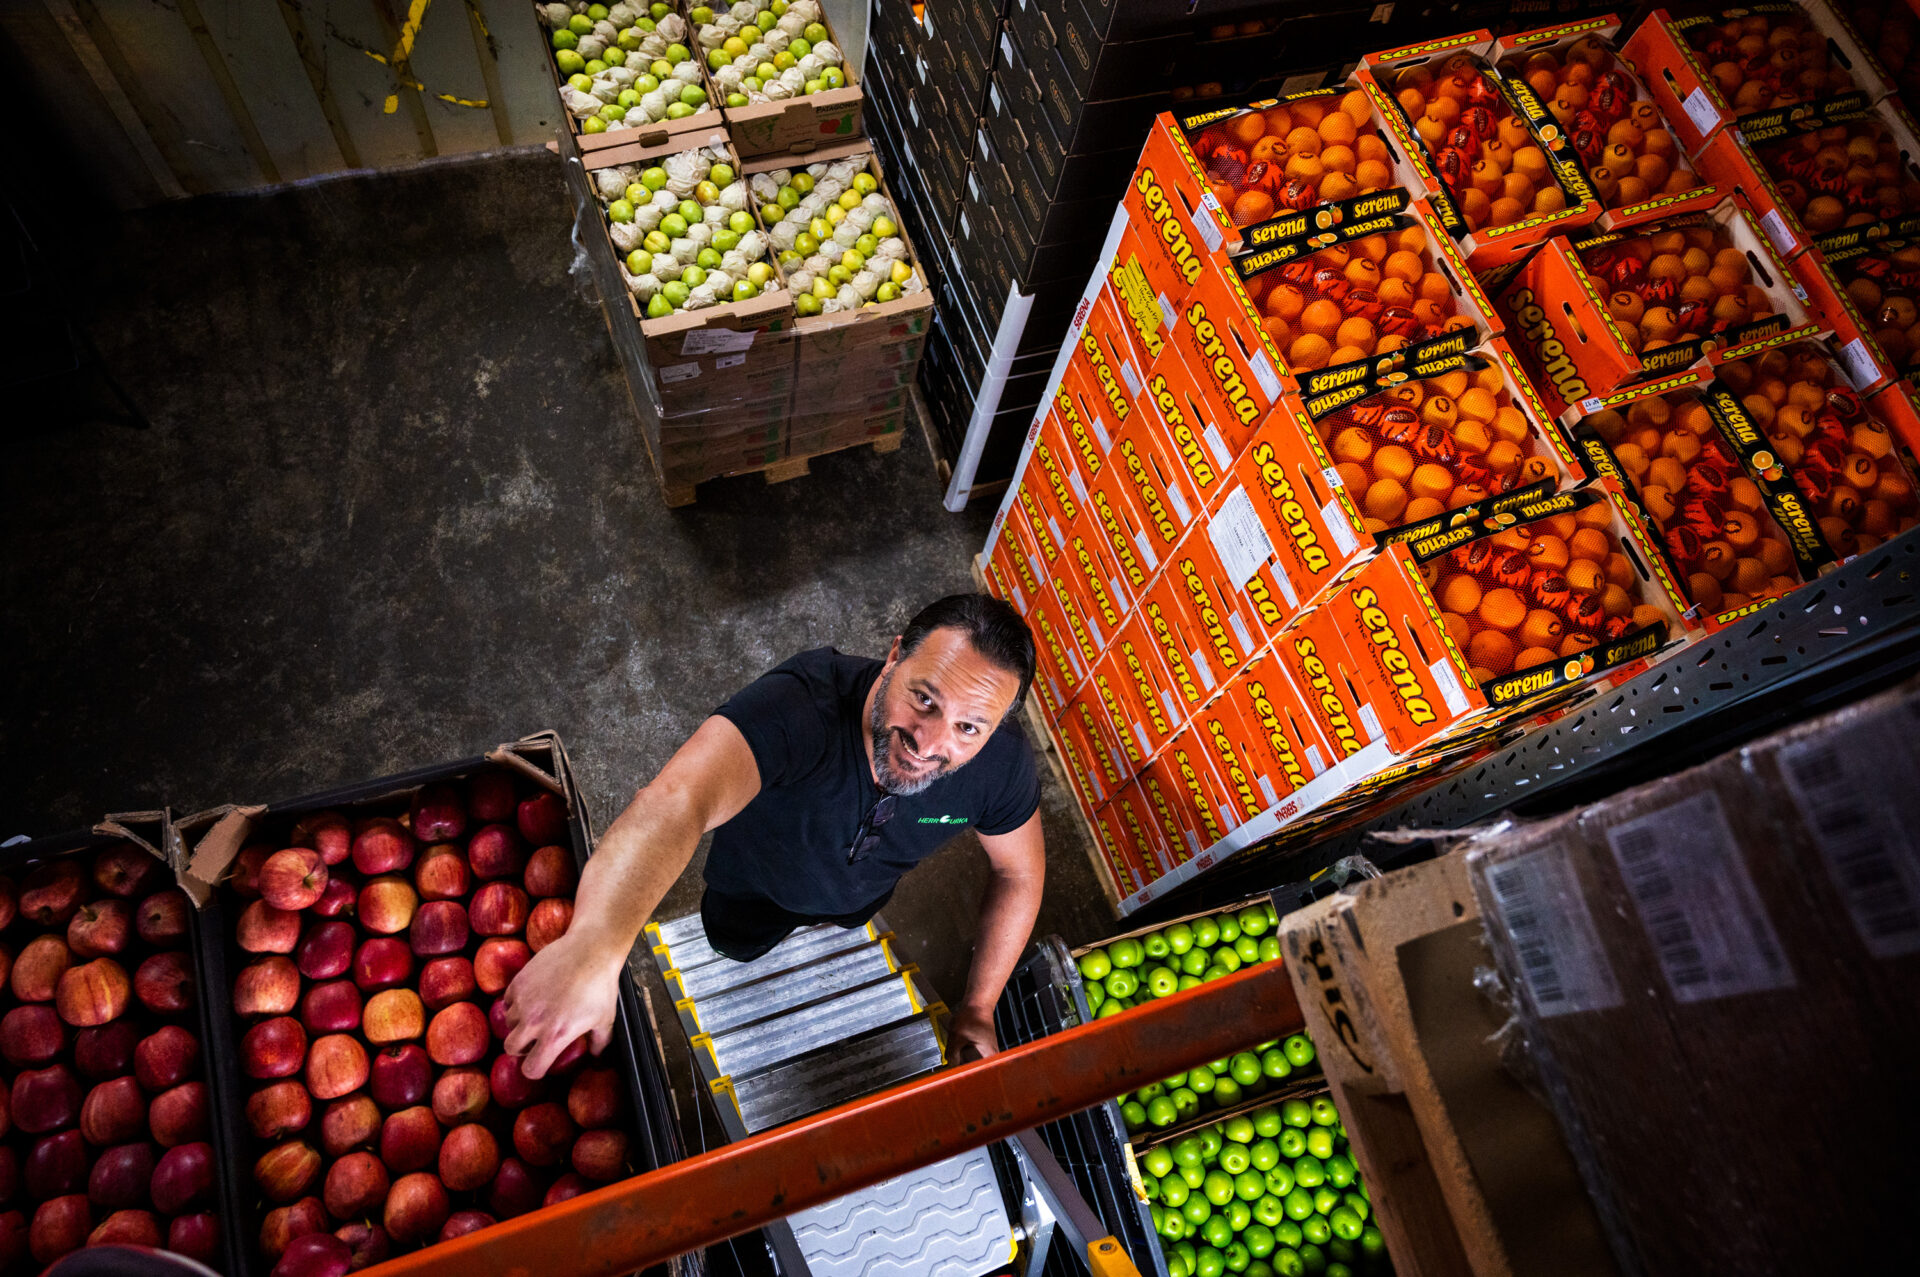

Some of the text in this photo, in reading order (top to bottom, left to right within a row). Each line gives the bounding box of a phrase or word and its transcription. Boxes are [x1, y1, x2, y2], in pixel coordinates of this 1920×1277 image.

[1379, 34, 1478, 61] serena
[1514, 18, 1608, 45] serena
[816, 102, 858, 113] PATAGONIA
[1365, 81, 1430, 180] serena
[1508, 78, 1546, 121] serena
[1354, 194, 1400, 218] serena
[1486, 205, 1588, 238] serena
[1561, 160, 1595, 204] seren
[1622, 185, 1717, 216] serena
[1136, 167, 1203, 286] serena
[1242, 244, 1296, 274] serena
[1252, 216, 1306, 244] serena
[1344, 216, 1394, 237] serena
[1425, 212, 1494, 319] serena
[1073, 297, 1091, 330] SERENA
[1224, 265, 1289, 377] serena
[1564, 249, 1633, 356] serena
[1721, 324, 1820, 361] serena
[1080, 322, 1132, 421] serena
[1187, 301, 1260, 427] serena
[1310, 365, 1367, 393] serena
[1414, 354, 1466, 375] serena
[1418, 337, 1464, 360] serena
[1508, 288, 1591, 406] serena
[1643, 347, 1693, 371] serena
[1056, 381, 1102, 474] serena
[1150, 374, 1215, 488] serena
[1308, 384, 1366, 417] serena
[1502, 351, 1574, 465] serena
[1714, 392, 1760, 444] serena
[1035, 434, 1077, 520] serena
[1120, 438, 1178, 544] serena
[1252, 441, 1330, 574] serena
[1522, 494, 1575, 517] serena
[1002, 519, 1037, 595] serena
[1018, 481, 1057, 562] serena
[1094, 489, 1145, 587] serena
[1415, 526, 1474, 558] serena
[1611, 491, 1686, 615] serena
[1775, 492, 1821, 549] serena
[1053, 576, 1096, 663] serena
[1072, 536, 1118, 628] serena
[1179, 557, 1239, 669] serena
[1036, 608, 1076, 689] serena
[1147, 602, 1201, 703] serena
[1351, 586, 1437, 727] serena
[1403, 558, 1477, 690] serena
[1606, 632, 1656, 665] serena
[1096, 674, 1141, 763] serena
[1121, 640, 1169, 736] serena
[1294, 636, 1363, 758] serena
[1494, 669, 1554, 702] serena
[1060, 727, 1095, 804] serena
[1078, 702, 1118, 784] serena
[1207, 718, 1263, 819] serena
[1247, 681, 1309, 792] serena
